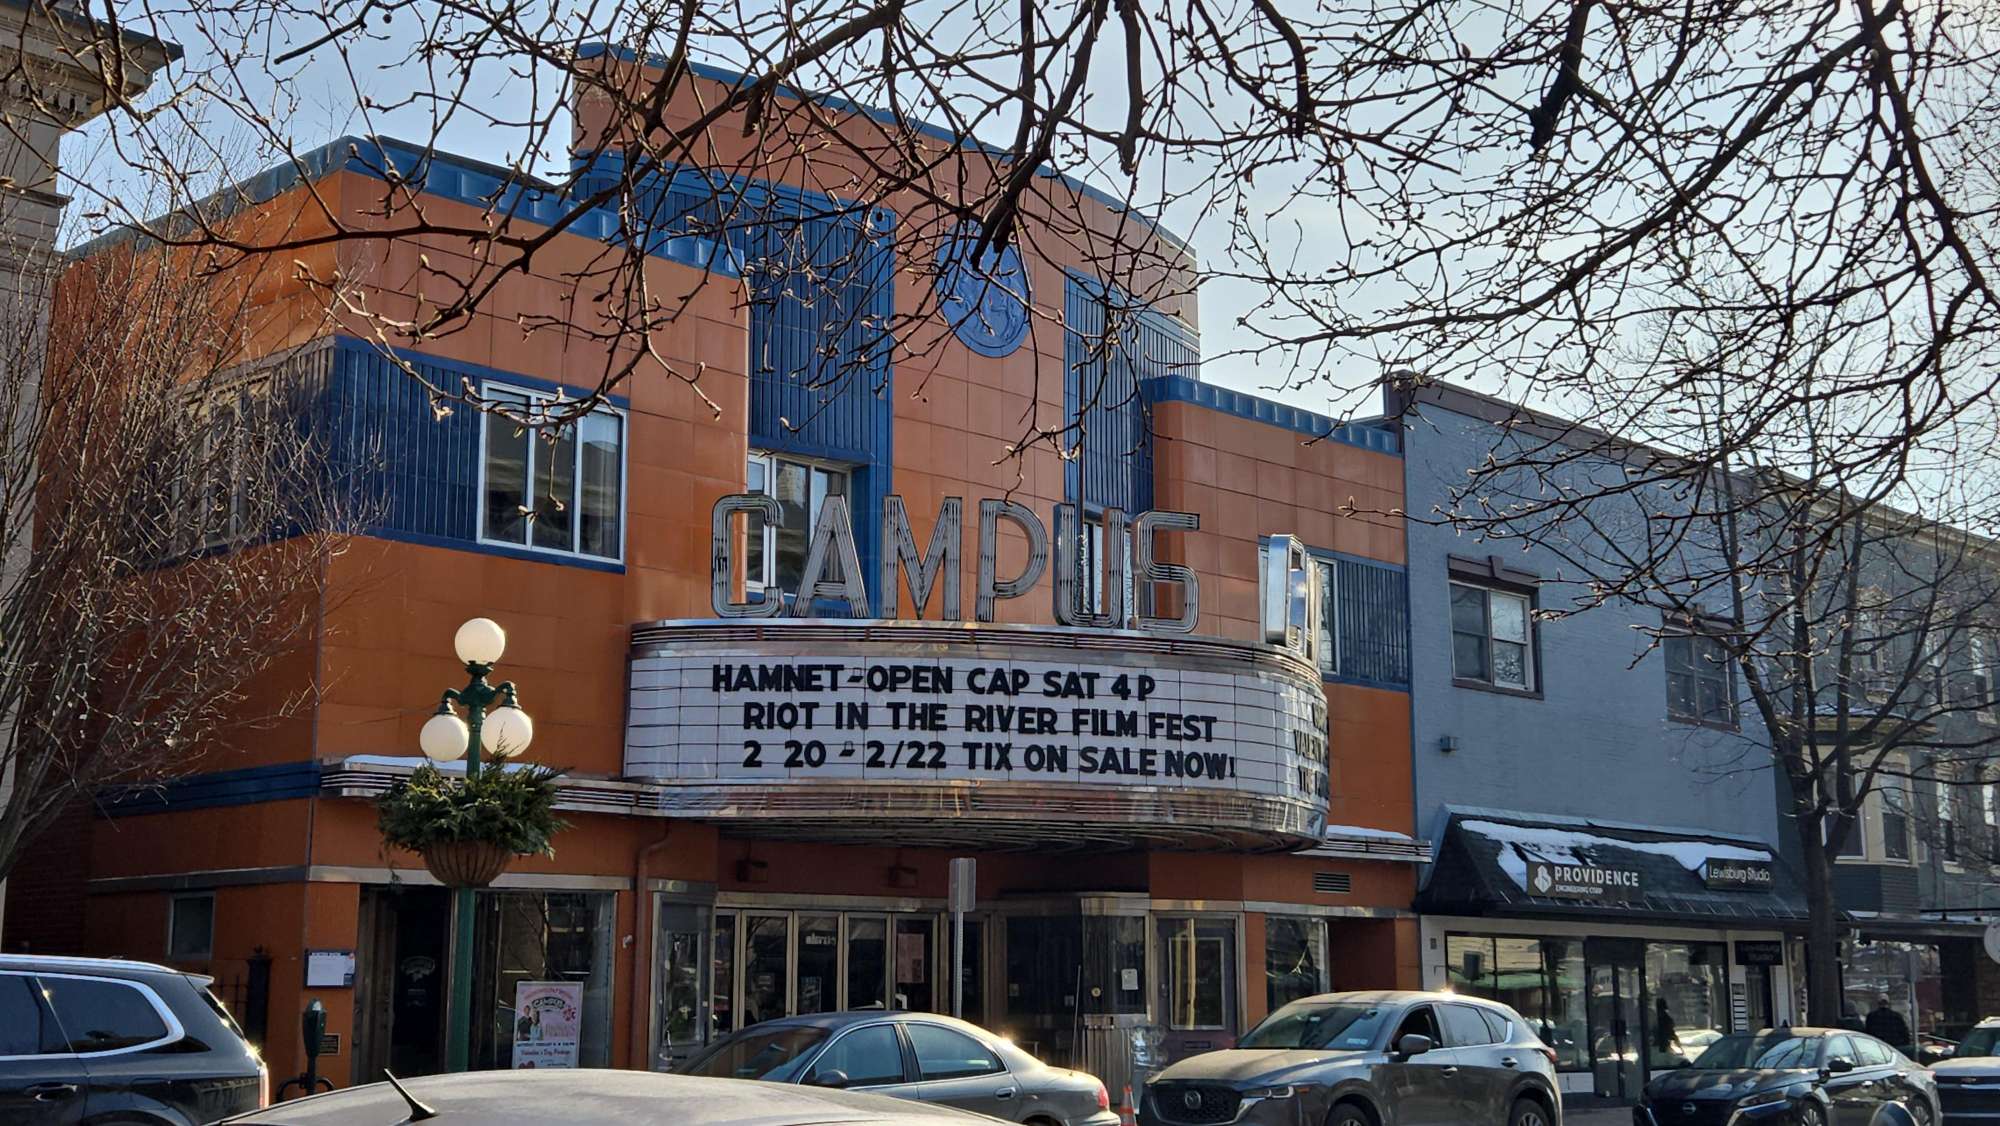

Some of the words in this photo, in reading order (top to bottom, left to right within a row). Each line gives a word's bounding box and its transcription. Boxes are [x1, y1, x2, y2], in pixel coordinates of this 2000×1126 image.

[711, 494, 1201, 632] CAMPUS
[967, 668, 1030, 696] CAP
[1043, 671, 1100, 699] SAT
[743, 702, 820, 730] RIOT
[835, 702, 869, 730] IN
[886, 702, 948, 731] THE
[965, 704, 1058, 735] RIVER
[1072, 708, 1138, 737] FILM
[1149, 711, 1218, 743] FEST
[866, 740, 947, 769] 2/22
[962, 741, 1013, 771] TIX
[1024, 744, 1068, 773] ON
[1078, 746, 1158, 777] SALE
[1165, 750, 1236, 780] NOW!
[1553, 866, 1640, 887] PROVIDENCE
[1709, 864, 1747, 883] Lewisburg
[1747, 866, 1771, 881] Studio
